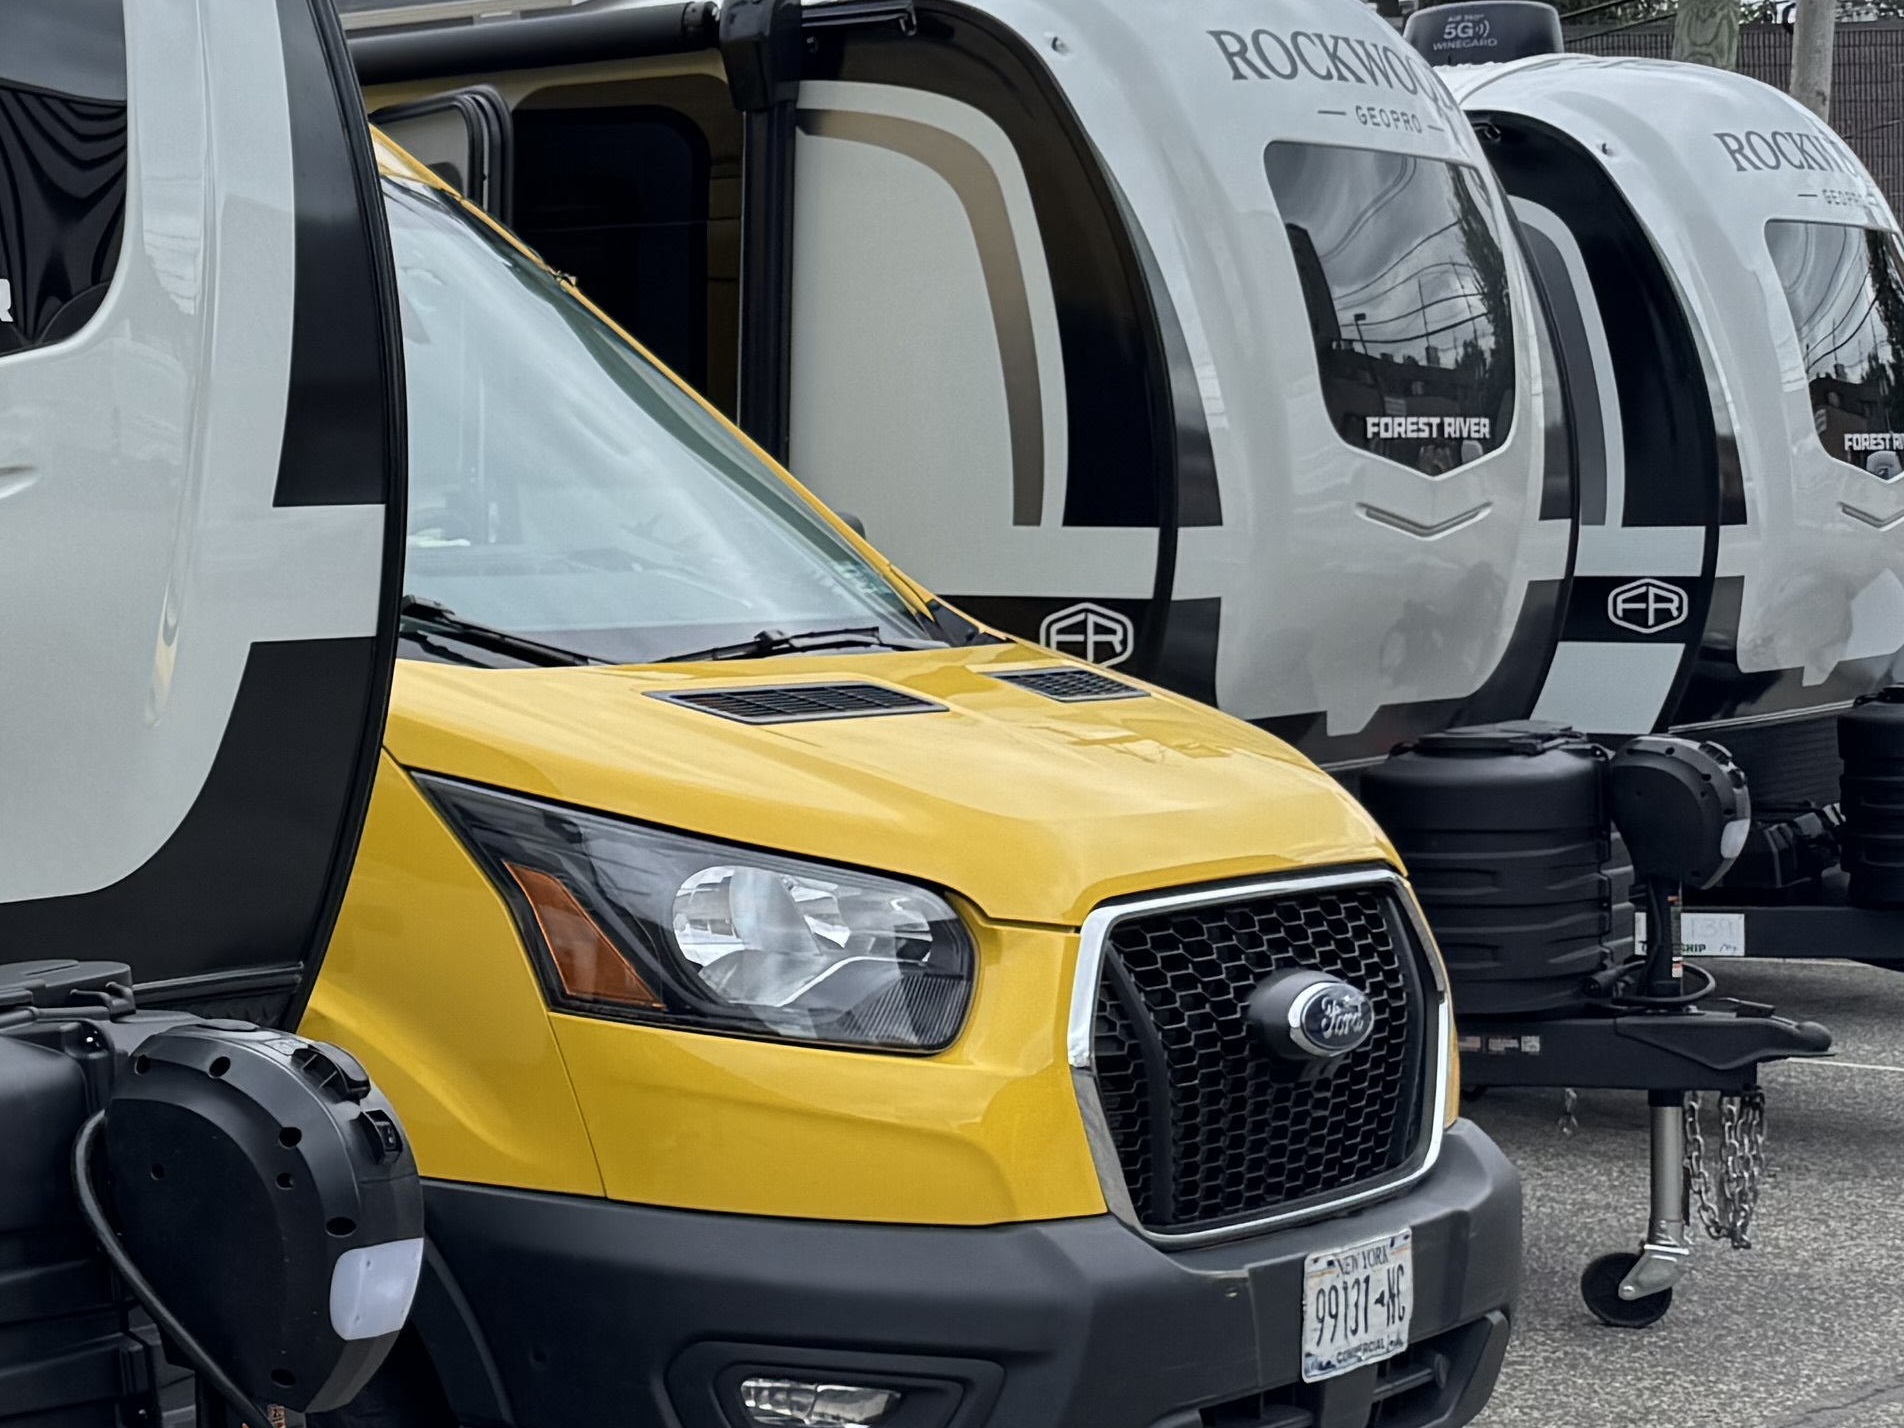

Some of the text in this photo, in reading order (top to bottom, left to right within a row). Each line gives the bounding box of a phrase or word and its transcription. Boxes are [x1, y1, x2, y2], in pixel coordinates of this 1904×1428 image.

[1443, 22, 1474, 39] 5G
[1432, 37, 1498, 51] WINEGARD
[1355, 105, 1423, 134] GEOPRO
[1365, 416, 1490, 439] FOREST RIVER
[1843, 432, 1891, 451] FOREST
[1320, 994, 1364, 1040] Ford
[1361, 1244, 1390, 1270] YORK
